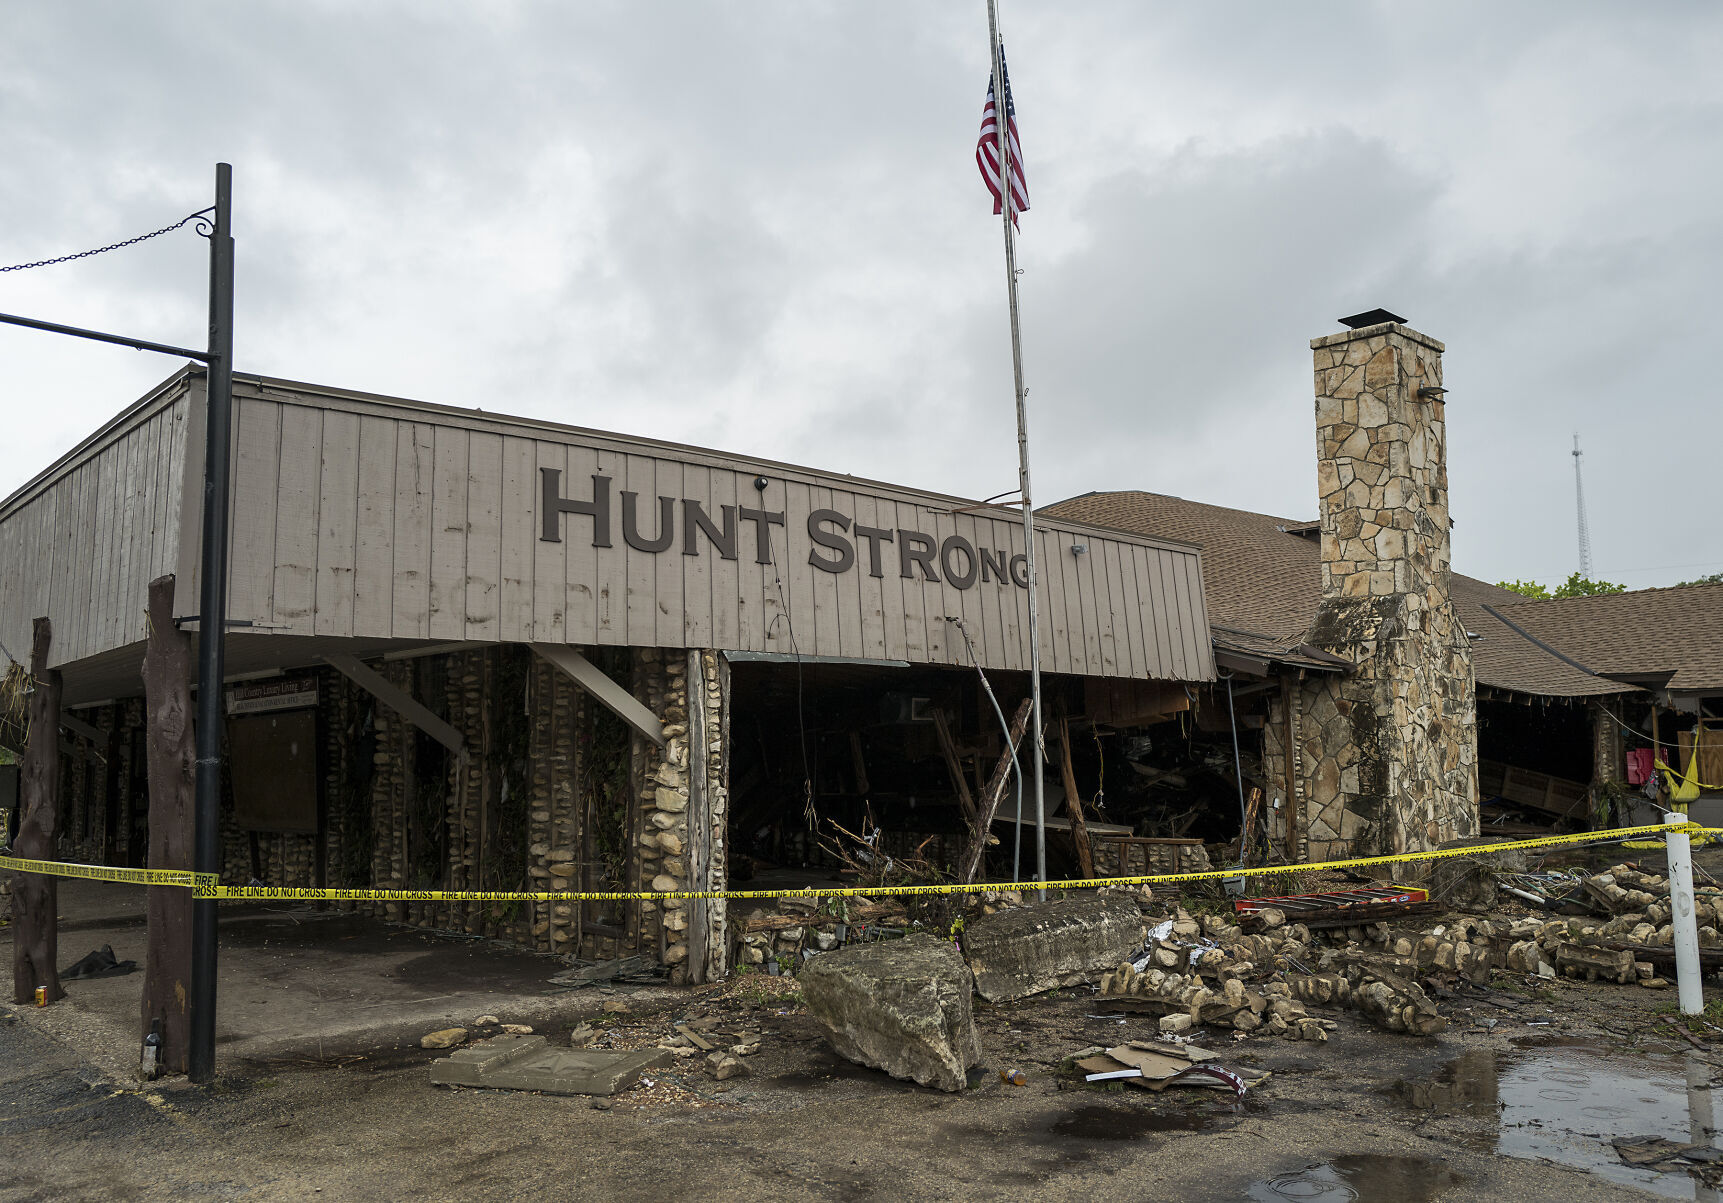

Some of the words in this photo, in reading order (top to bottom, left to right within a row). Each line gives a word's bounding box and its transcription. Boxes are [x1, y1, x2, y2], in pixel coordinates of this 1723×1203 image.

[539, 467, 785, 565] HUNT
[808, 508, 1037, 590] STRONG
[195, 874, 212, 886] FIRE
[226, 886, 244, 897] FIRE
[247, 886, 264, 897] LINE
[267, 887, 278, 897] DO
[281, 887, 296, 898] NOT
[299, 888, 326, 898] CROSS
[335, 888, 352, 898] FIRE
[354, 889, 372, 898] LINE
[374, 890, 386, 898] DO
[389, 890, 404, 899] NOT
[406, 890, 432, 899] CROSS
[442, 891, 458, 899] FIRE
[461, 891, 478, 900] LINE
[480, 892, 492, 900] DO
[494, 892, 508, 900] NOT
[512, 892, 538, 900] CROSS
[547, 892, 564, 900] FIRE
[566, 892, 582, 900] LINE
[586, 892, 596, 900] DO
[599, 892, 614, 900] NOT
